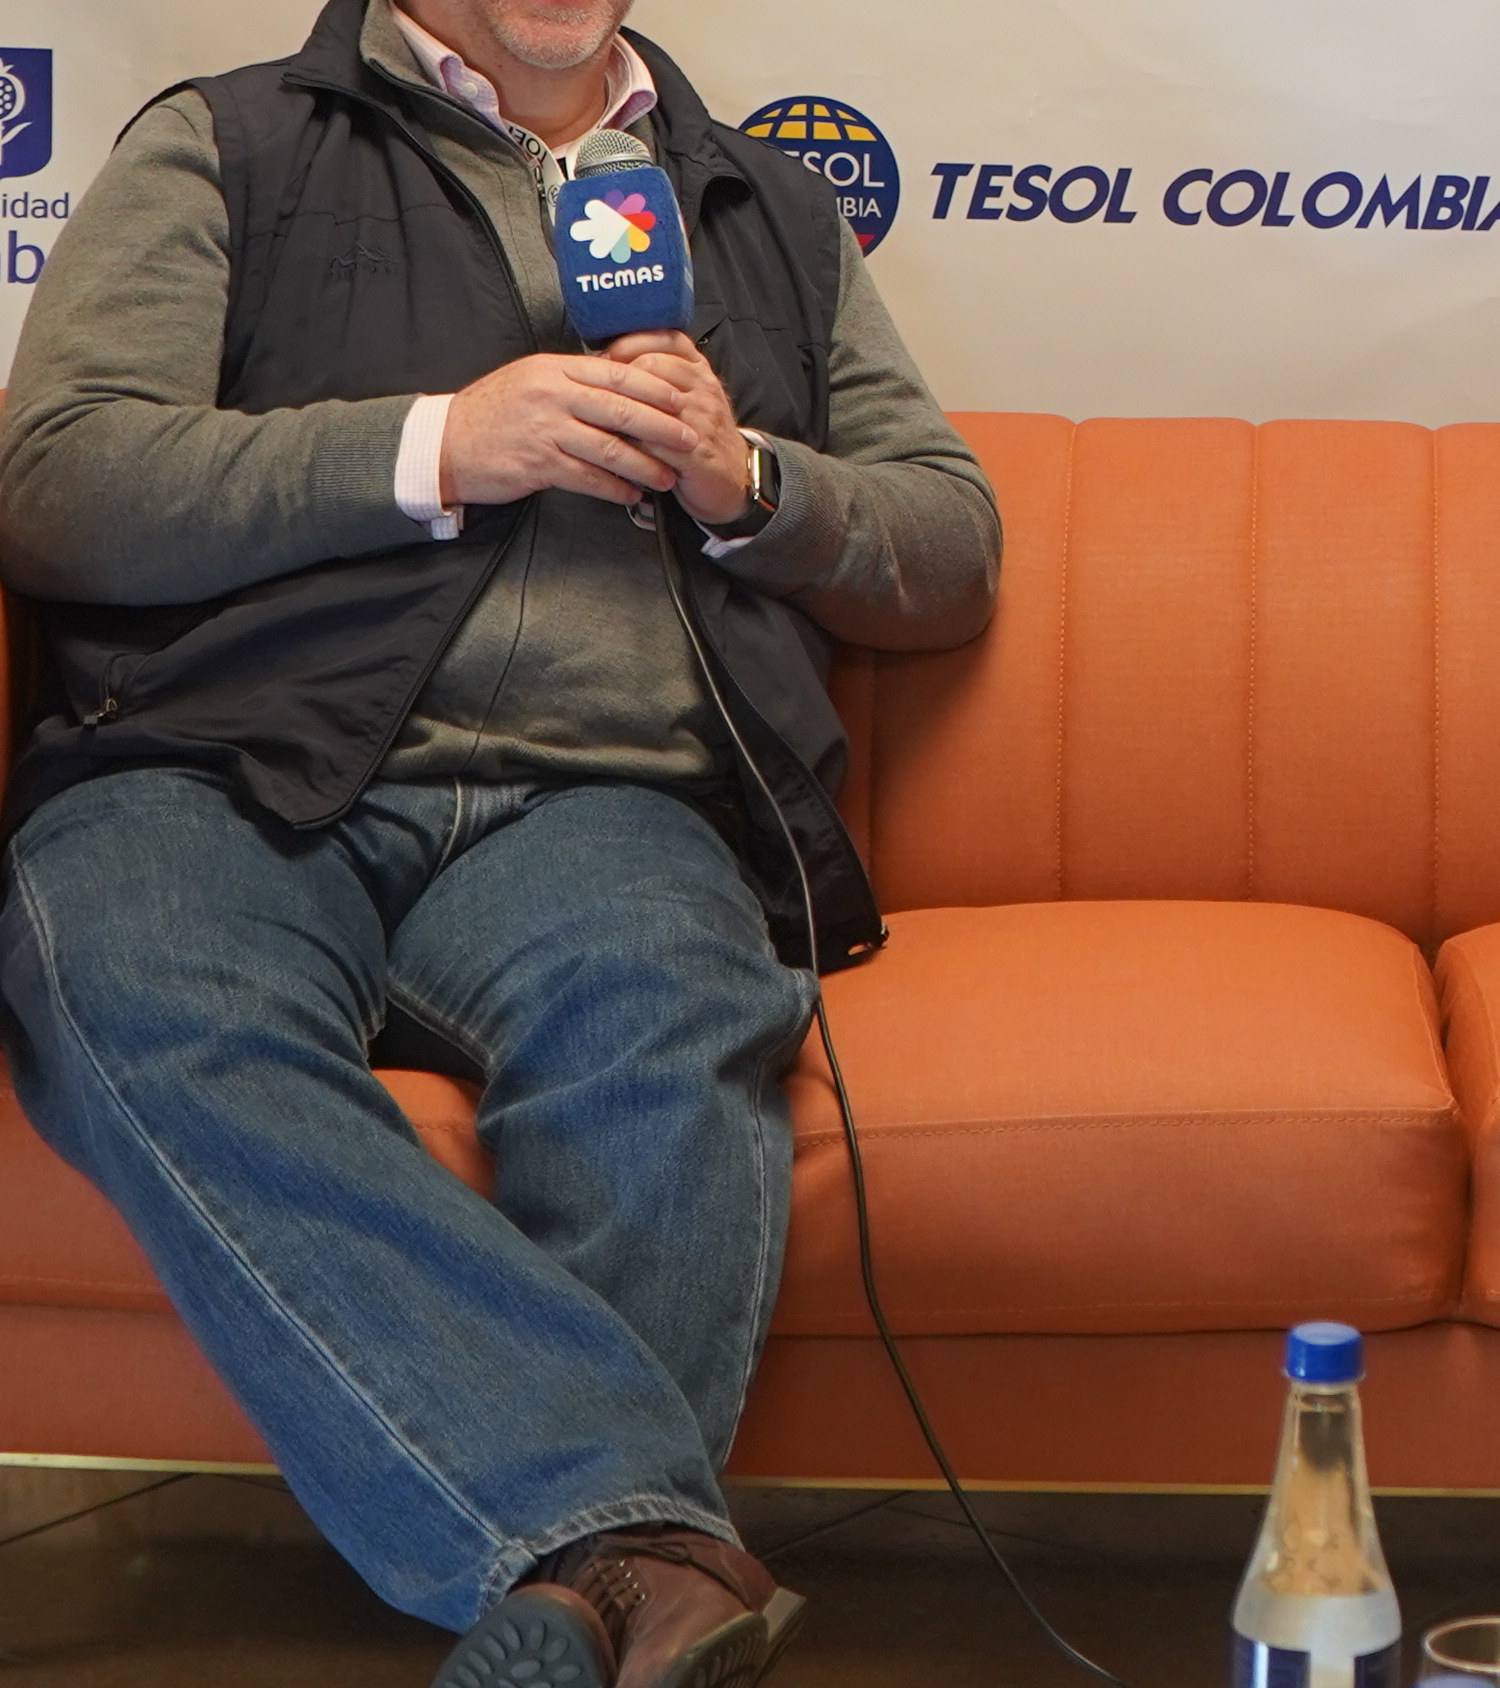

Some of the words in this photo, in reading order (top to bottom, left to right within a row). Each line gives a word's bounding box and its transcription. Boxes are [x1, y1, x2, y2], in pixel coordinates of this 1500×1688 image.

[784, 150, 885, 187] SOL
[930, 162, 1138, 224] TESOL
[576, 264, 665, 293] TICMAS
